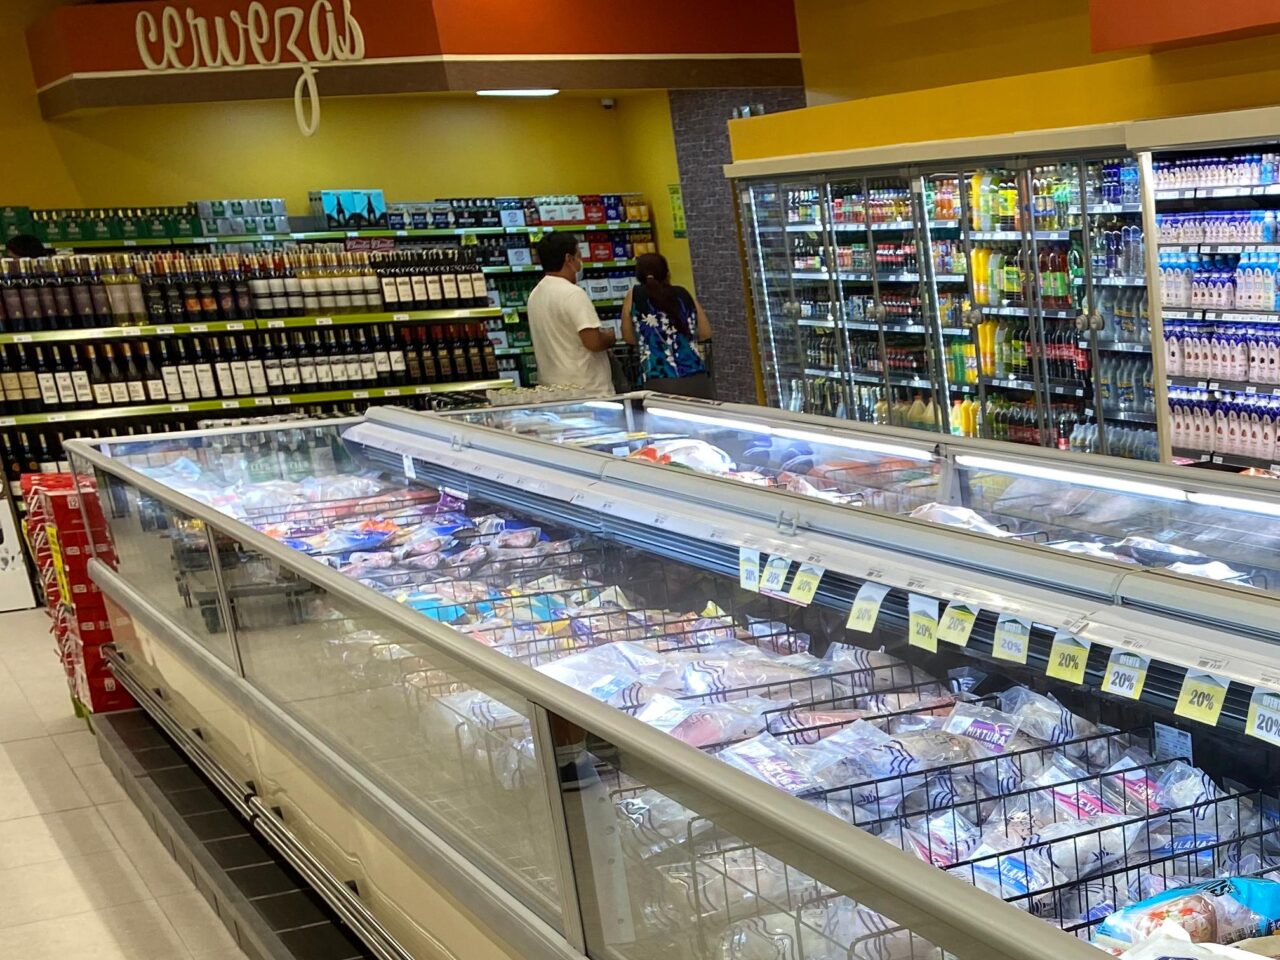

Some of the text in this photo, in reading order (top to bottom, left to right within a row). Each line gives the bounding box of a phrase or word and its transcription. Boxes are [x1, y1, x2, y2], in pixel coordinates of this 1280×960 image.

[135, 0, 365, 137] cervezas
[916, 622, 934, 641] 20%
[946, 616, 966, 634] 20%
[1000, 638, 1023, 654] 20%
[1058, 651, 1079, 672] 20%
[1110, 670, 1135, 691] 20%
[1188, 688, 1215, 711] 20%
